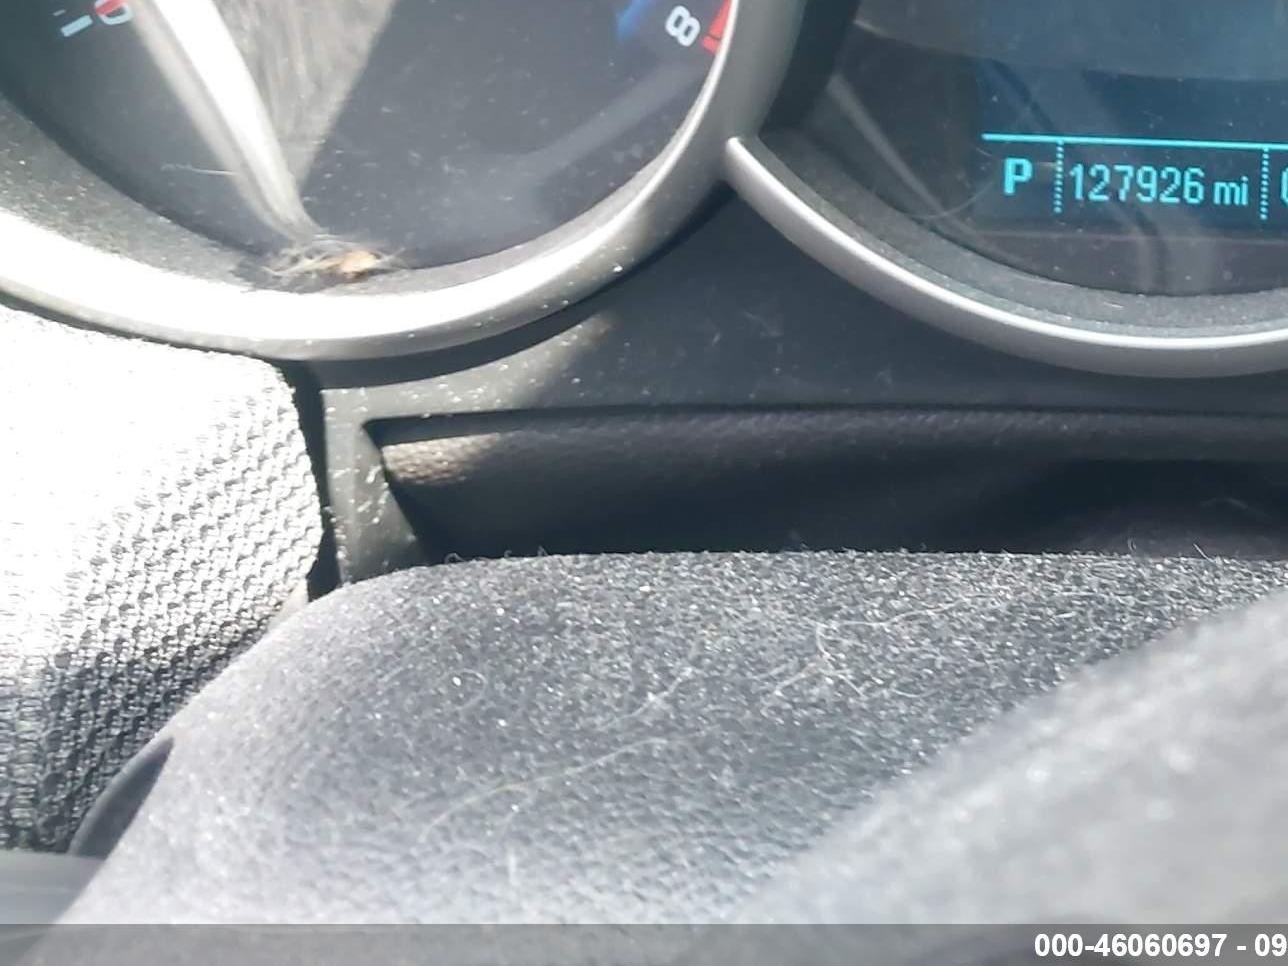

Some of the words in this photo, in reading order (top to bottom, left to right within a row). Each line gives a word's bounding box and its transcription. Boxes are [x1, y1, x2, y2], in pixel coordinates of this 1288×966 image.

[665, 5, 701, 47] 8
[1004, 157, 1033, 195] P
[1069, 163, 1205, 204] 127926
[1213, 176, 1249, 206] mi
